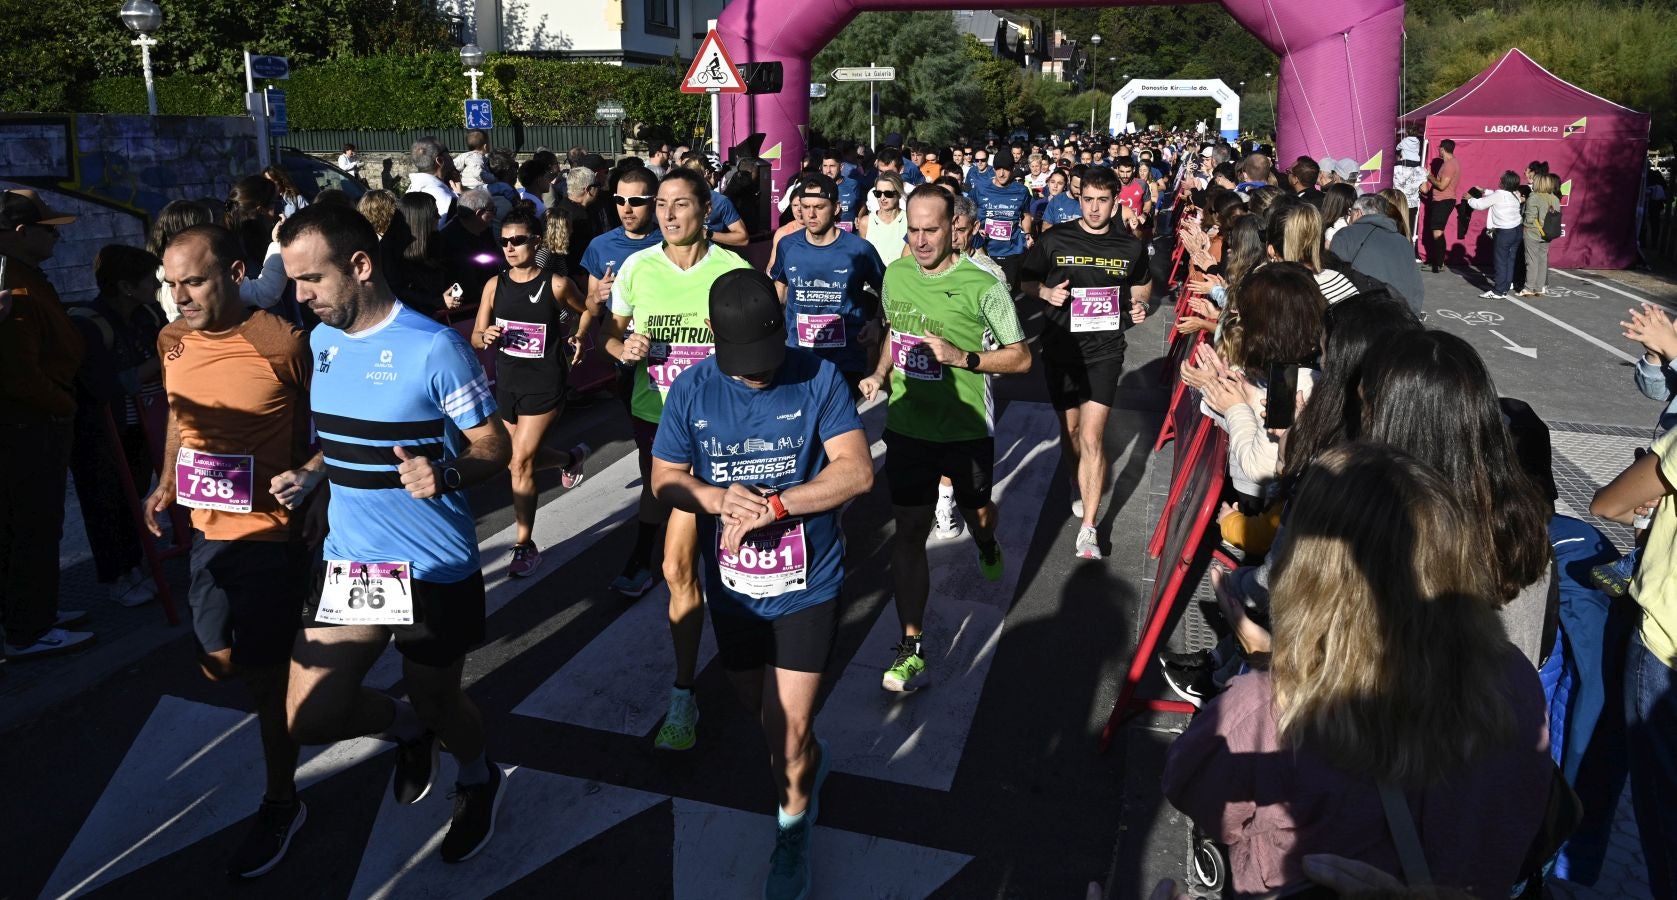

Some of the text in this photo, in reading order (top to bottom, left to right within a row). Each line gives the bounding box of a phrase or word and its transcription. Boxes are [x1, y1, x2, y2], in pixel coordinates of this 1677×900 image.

[1485, 125, 1559, 133] LABORAL kutxa
[990, 227, 1007, 237] 733
[1056, 255, 1130, 268] DROP SHOT
[1081, 301, 1113, 314] 729
[647, 314, 682, 327] BINTER
[805, 327, 835, 341] 567
[898, 349, 929, 370] 688
[365, 371, 398, 382] KOTAI
[654, 364, 693, 384] 10
[194, 459, 216, 467] LABORAL
[731, 459, 797, 476] KROSSA
[194, 468, 224, 478] PINILLA
[732, 474, 759, 482] CROSS
[187, 473, 235, 499] 738
[347, 586, 386, 610] 86
